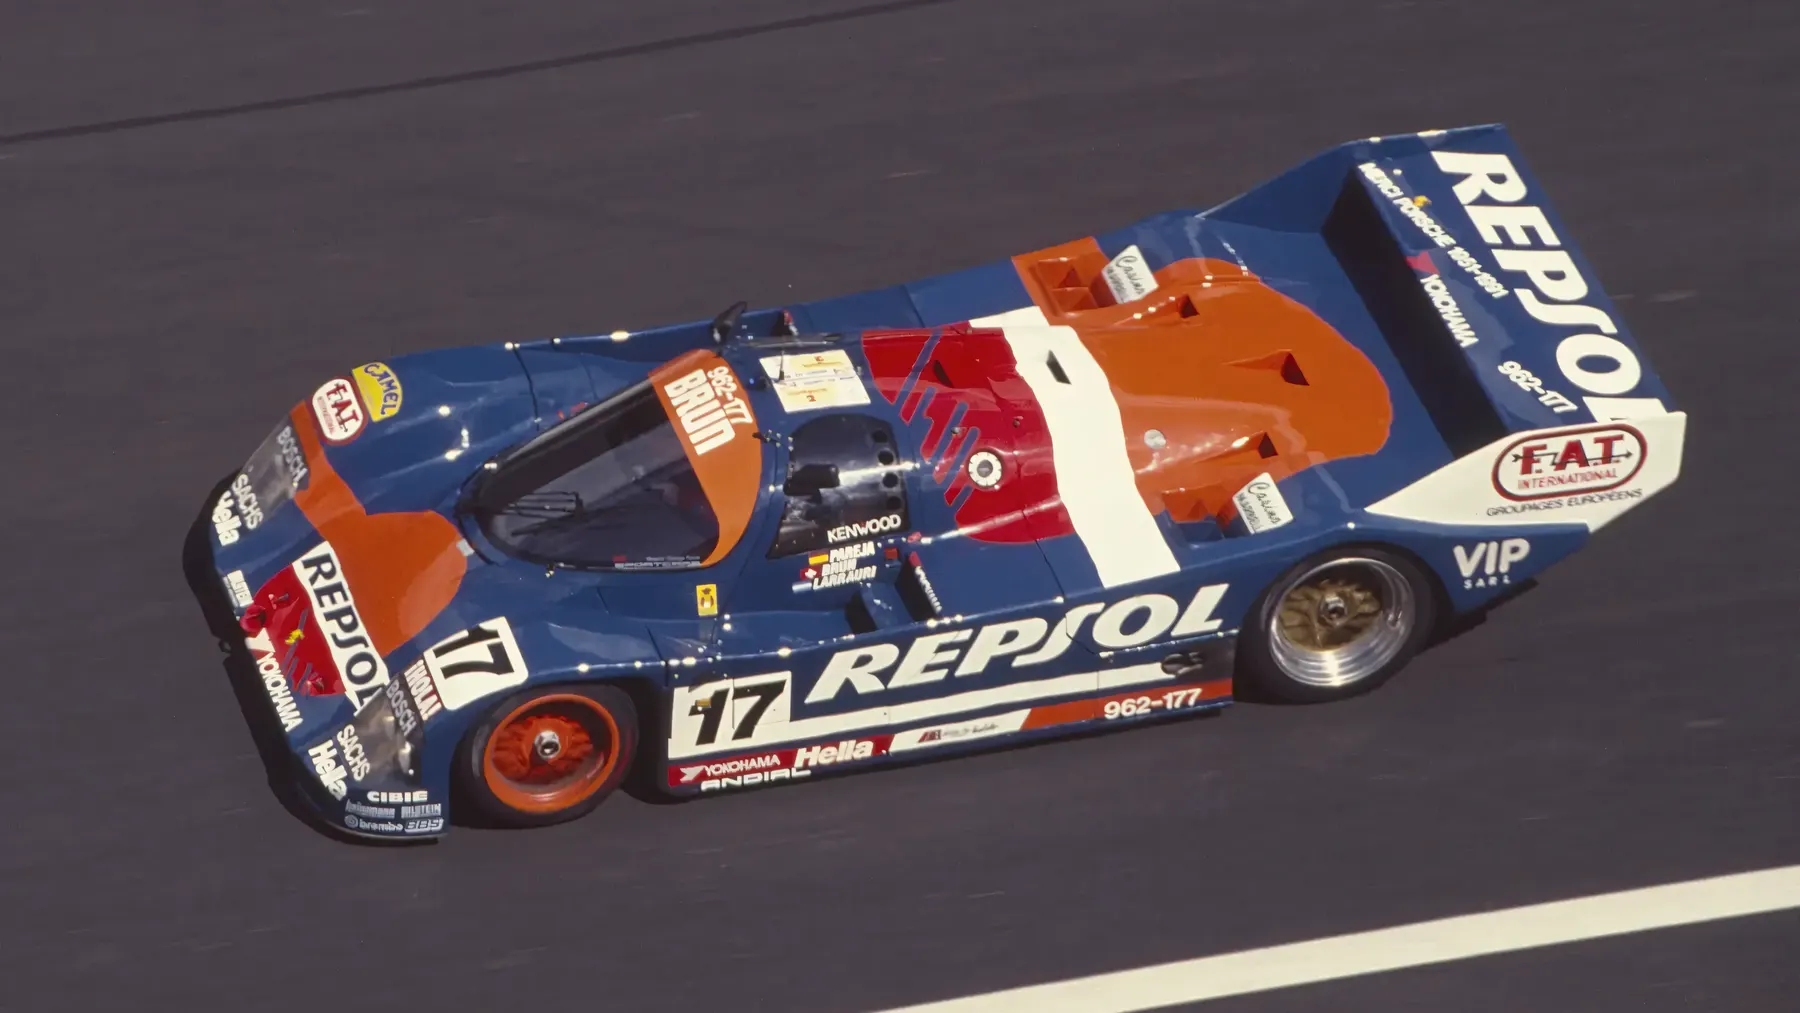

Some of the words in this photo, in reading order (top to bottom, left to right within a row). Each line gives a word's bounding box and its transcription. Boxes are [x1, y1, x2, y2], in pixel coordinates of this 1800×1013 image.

[1358, 162, 1404, 198] MERCI
[1393, 197, 1456, 248] PORSCHE
[1420, 274, 1479, 348] YOKOHAMA
[1431, 151, 1667, 421] REPSOL
[364, 363, 400, 415] CAMEL
[664, 368, 736, 456] BRUN
[707, 365, 754, 424] 962-177
[1498, 360, 1578, 413] 962-177
[276, 425, 308, 481] BOSCH
[1517, 468, 1618, 490] INTERNATIONAL
[231, 474, 264, 530] SACHS
[827, 513, 902, 543] KENWOOD
[1486, 499, 1564, 516] GROUPAGES
[812, 566, 877, 591] LARRAURI
[820, 558, 857, 577] BRUN
[829, 541, 875, 563] PAREJA
[1452, 538, 1531, 578] VIP
[302, 552, 386, 707] REPSOL
[432, 624, 515, 680] 17
[804, 583, 1229, 704] REPSOL
[256, 652, 304, 733] YOKOHAMA
[386, 679, 417, 736] BOSCH
[688, 679, 787, 746] 17
[1104, 688, 1202, 720] 962-177
[308, 740, 348, 801] Hella
[337, 724, 370, 781] SACHS
[701, 767, 811, 792] ANDIAL
[704, 754, 781, 778] YOKOHAMA
[793, 740, 873, 769] Hella
[367, 791, 428, 803] CIBIE
[359, 818, 404, 832] brembo
[404, 818, 444, 833] BBS
